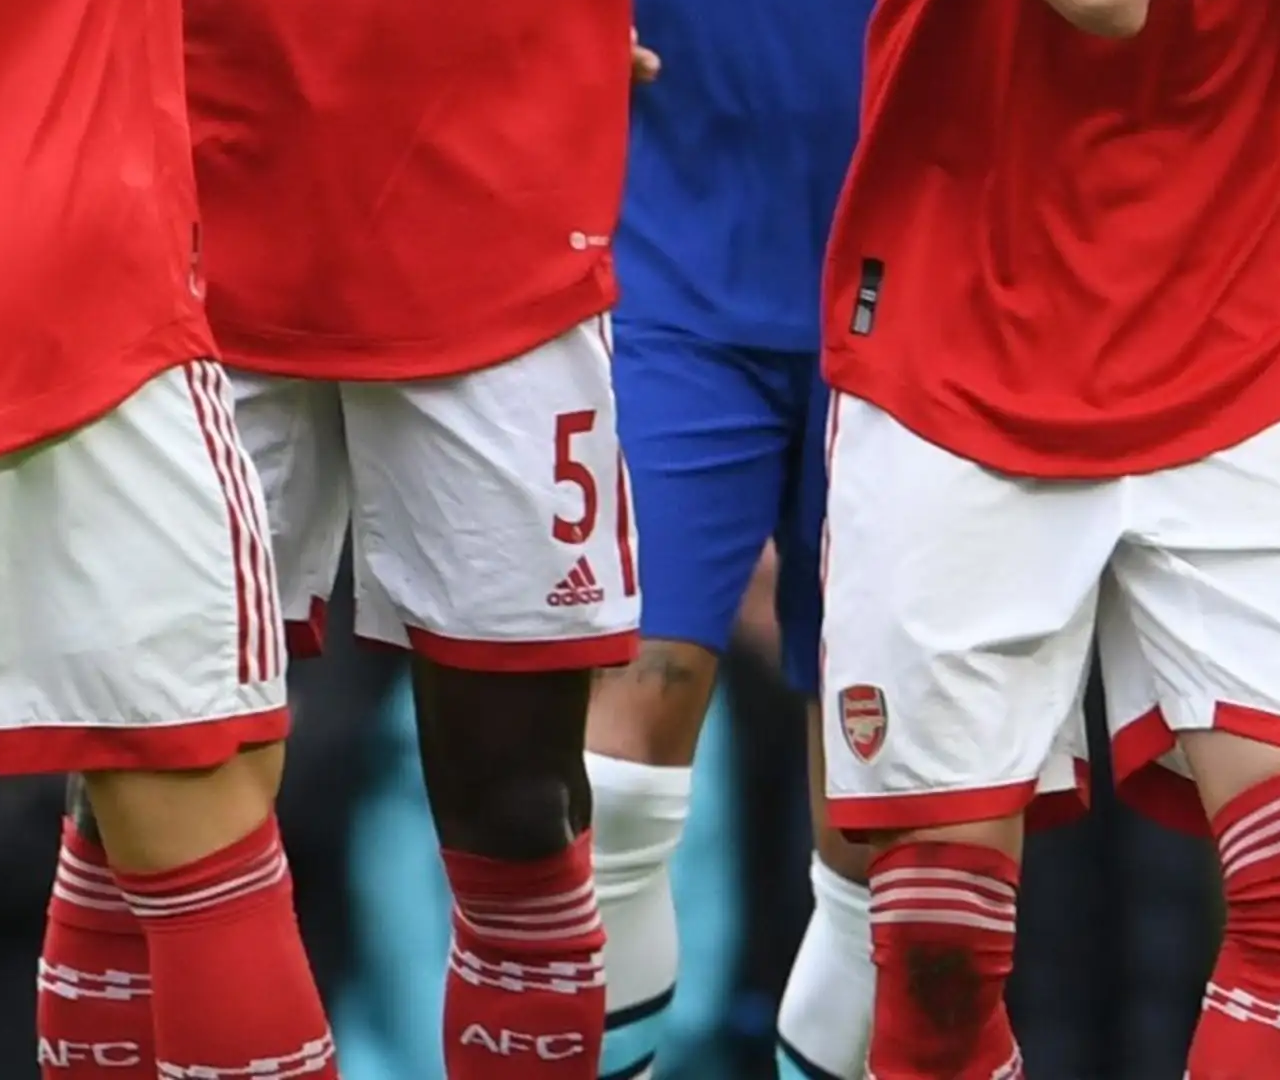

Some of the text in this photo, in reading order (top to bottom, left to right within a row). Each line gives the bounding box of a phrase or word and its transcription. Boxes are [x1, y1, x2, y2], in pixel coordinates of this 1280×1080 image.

[552, 410, 597, 545] 5
[37, 1038, 140, 1068] AFC
[461, 1024, 584, 1060] AFC
